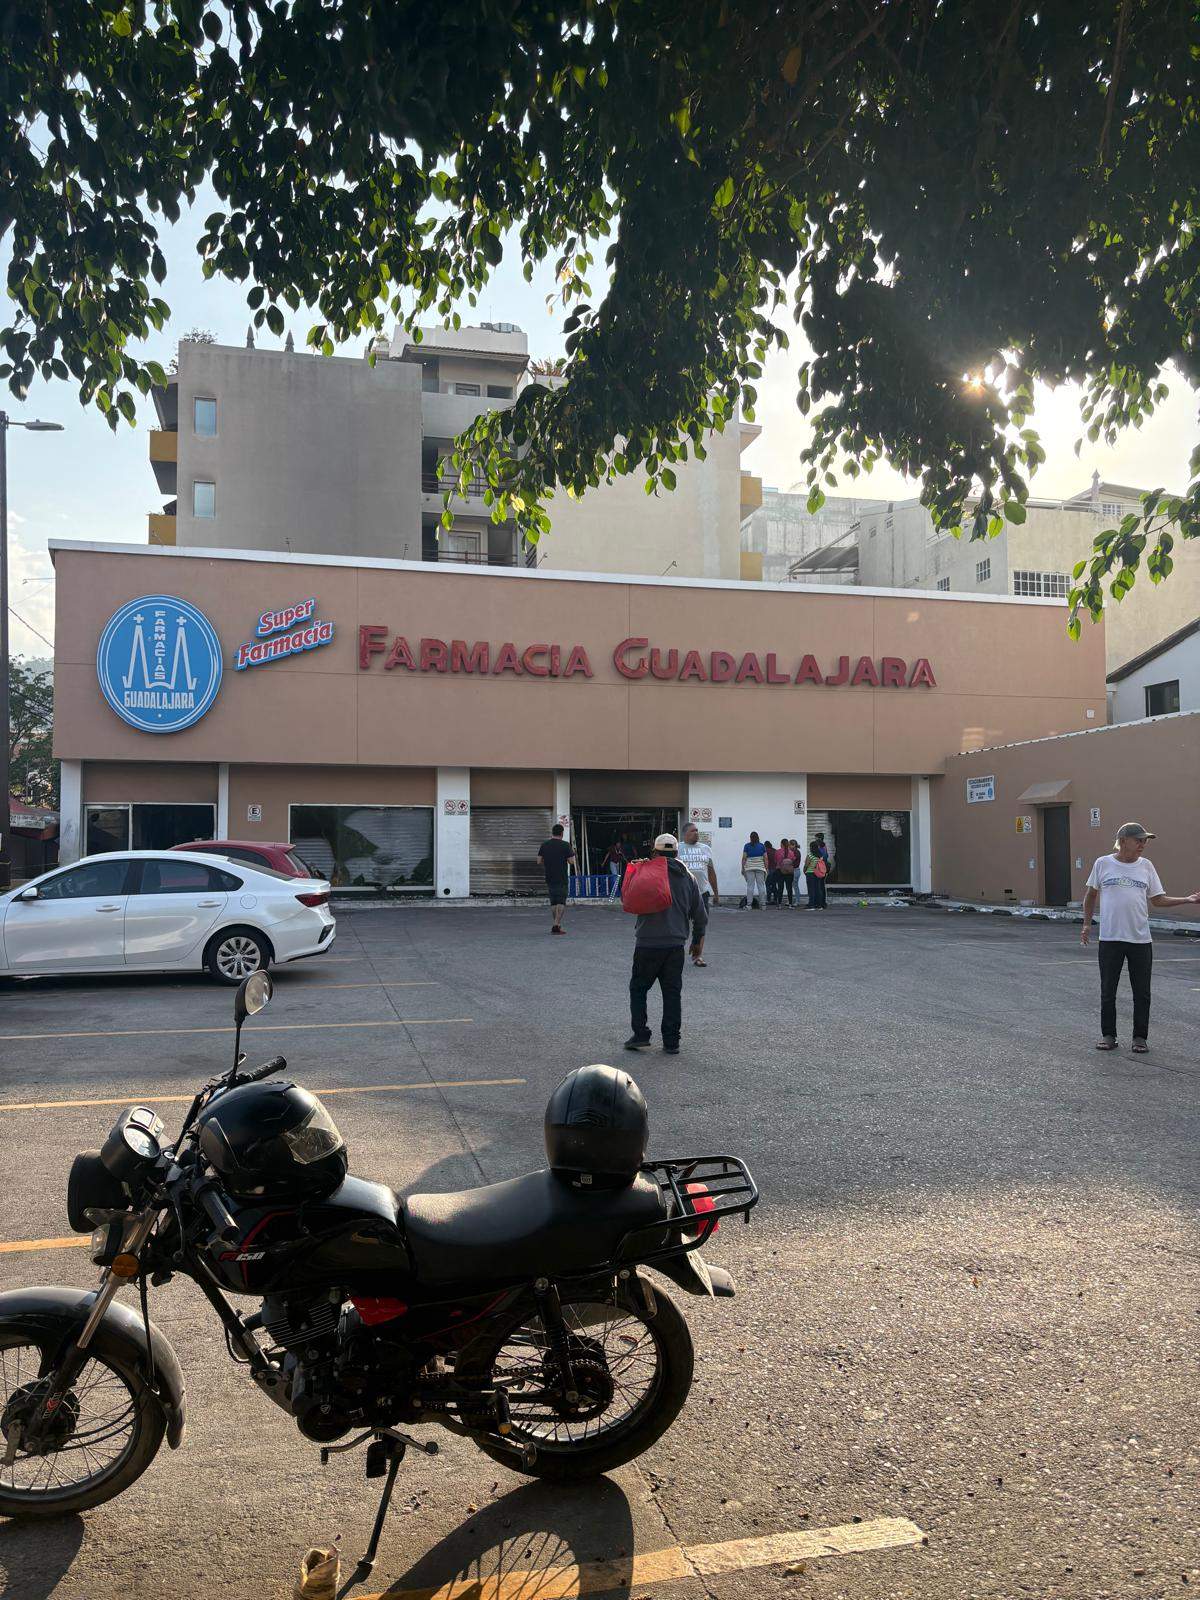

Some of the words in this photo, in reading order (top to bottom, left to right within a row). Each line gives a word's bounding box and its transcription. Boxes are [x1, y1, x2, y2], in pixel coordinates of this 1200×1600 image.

[257, 599, 315, 634] Super
[154, 610, 166, 680] FARMACIAS
[237, 620, 333, 667] Farmacia
[359, 625, 594, 678] FARMACIA
[613, 637, 938, 689] GUADALAJARA
[123, 690, 195, 709] GUADALAJARA
